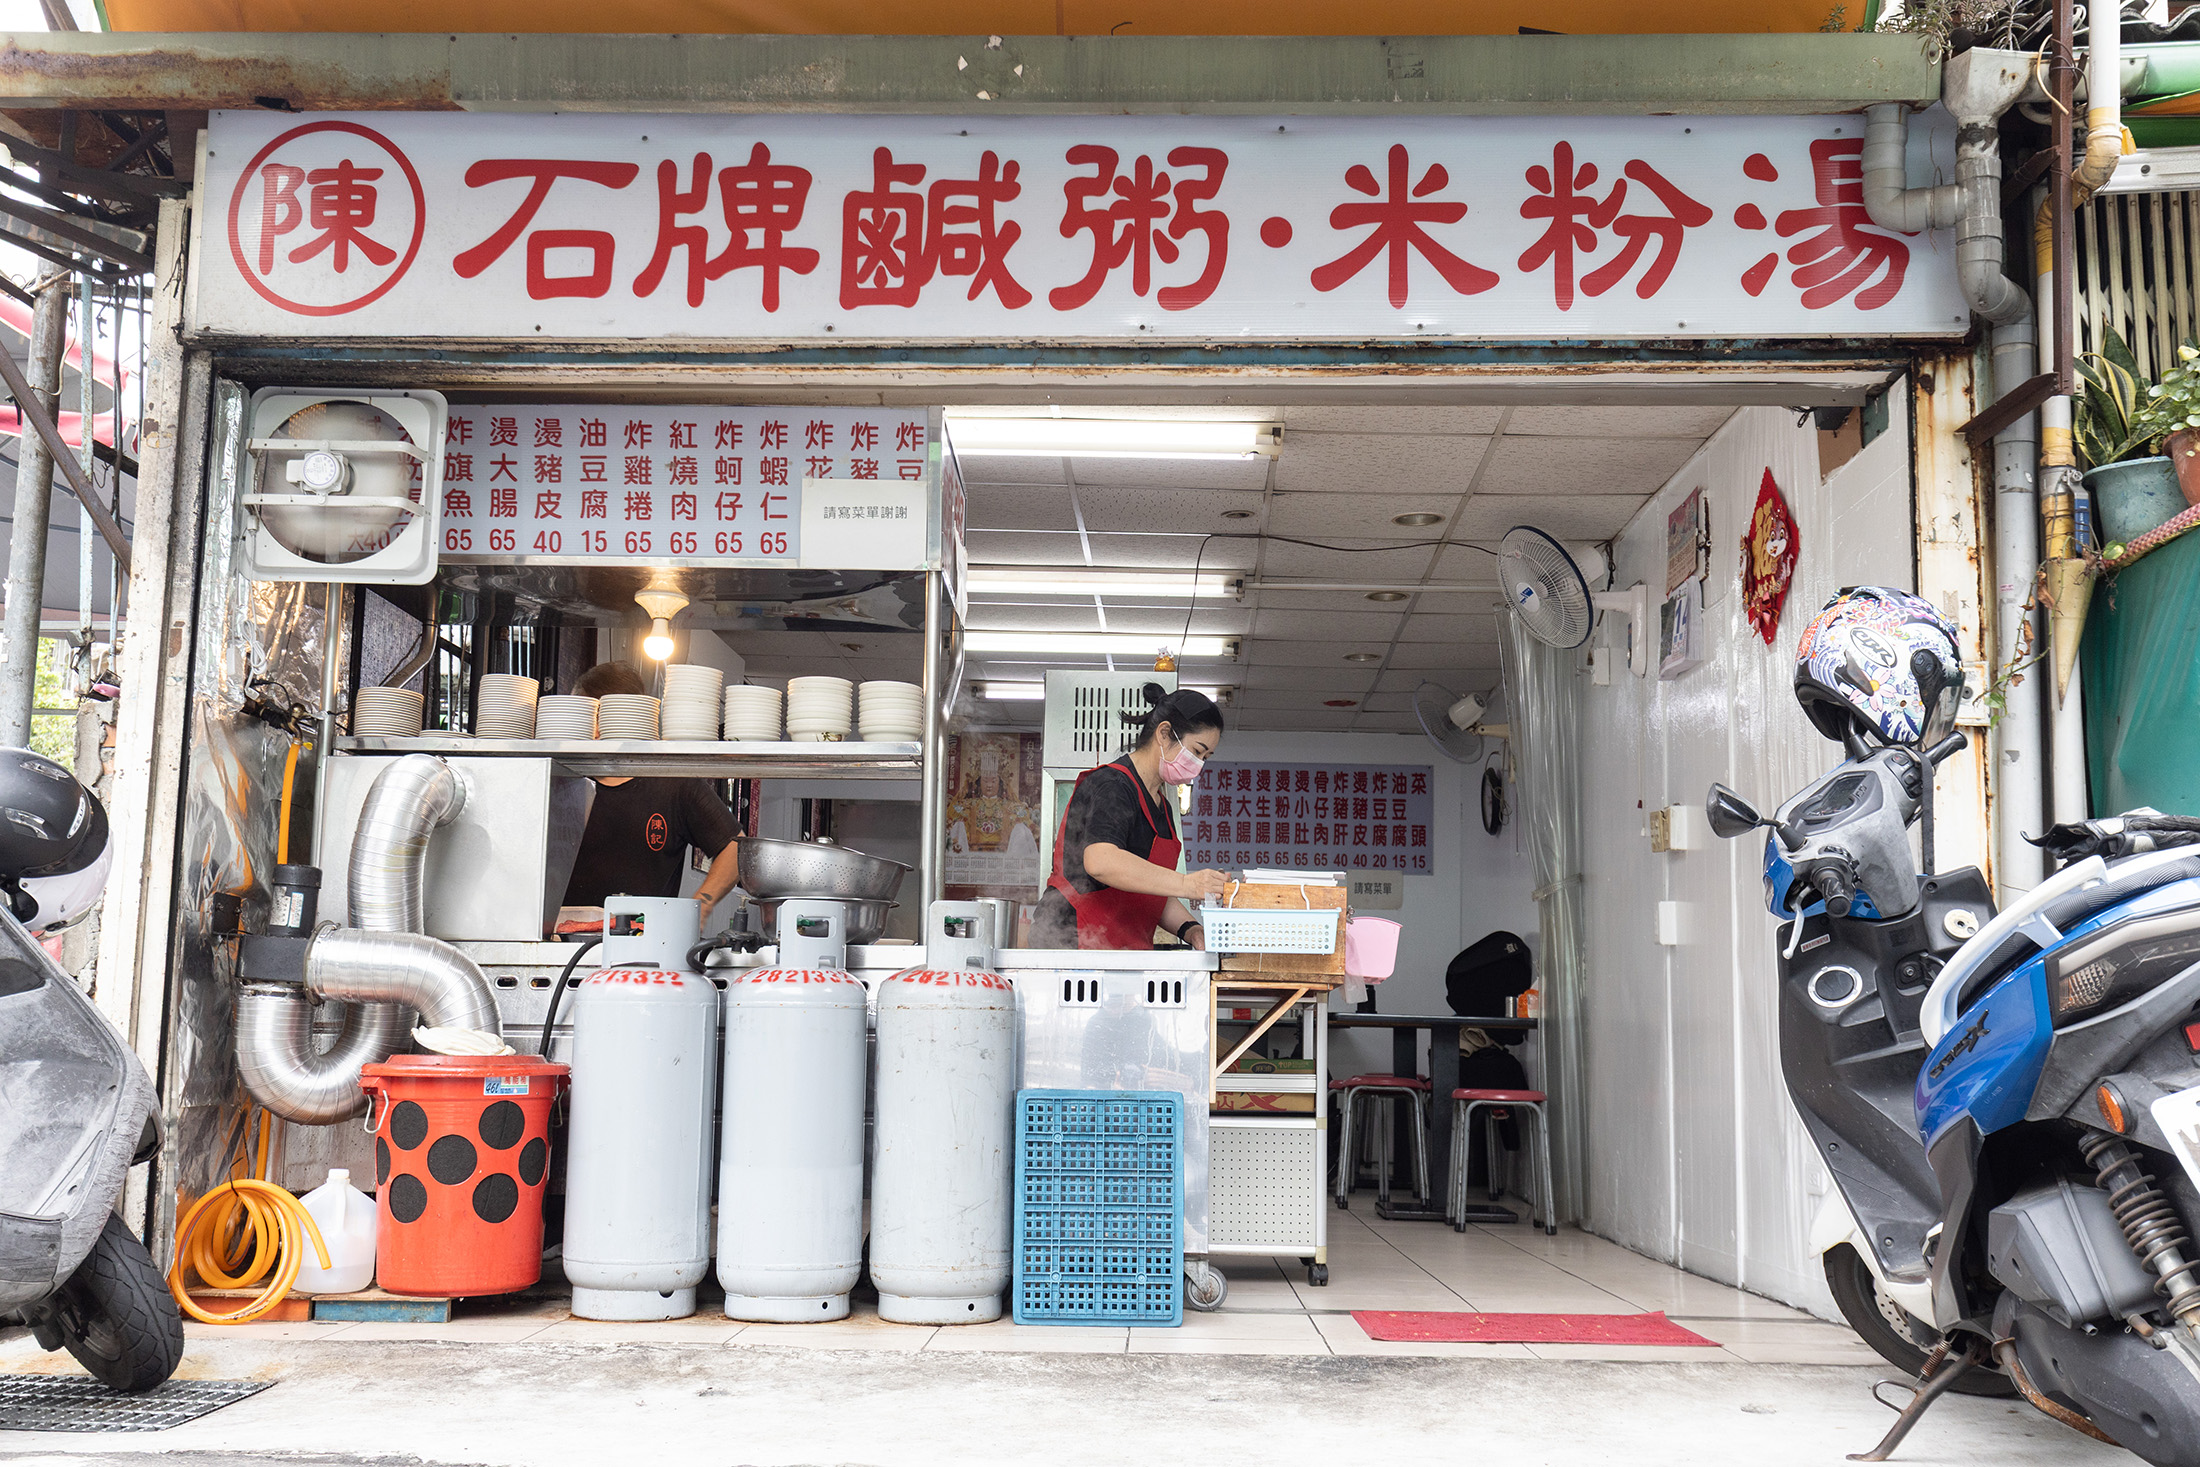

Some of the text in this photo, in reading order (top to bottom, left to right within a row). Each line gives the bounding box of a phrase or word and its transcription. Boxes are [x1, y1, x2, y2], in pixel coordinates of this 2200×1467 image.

[261, 159, 397, 276] 陳
[442, 416, 473, 551] 炸旗魚 65
[489, 416, 518, 551] 燙大腸 65
[533, 417, 563, 553] 燙豬皮 40
[579, 417, 608, 553] 油豆腐 15
[624, 419, 653, 554] 炸雞捲 65
[669, 419, 699, 554] 紅燒肉 65
[714, 419, 743, 554] 炸蚵仔 65
[759, 419, 788, 554] 炸蝦仁 65
[823, 505, 908, 520] 請寫菜單謝謝
[651, 819, 664, 845] 陳記
[1197, 850, 1211, 863] 65
[1217, 850, 1230, 864] 65
[1236, 851, 1250, 864] 65
[1256, 852, 1270, 865] 65
[1275, 852, 1289, 866] 65
[1295, 852, 1308, 866] 65
[1314, 853, 1328, 866] 65
[1333, 854, 1348, 867] 40
[1353, 854, 1367, 868] 40
[1373, 854, 1387, 868] 20
[1393, 855, 1407, 868] 15
[1412, 856, 1426, 869] 15
[1354, 881, 1392, 895] 請寫菜單
